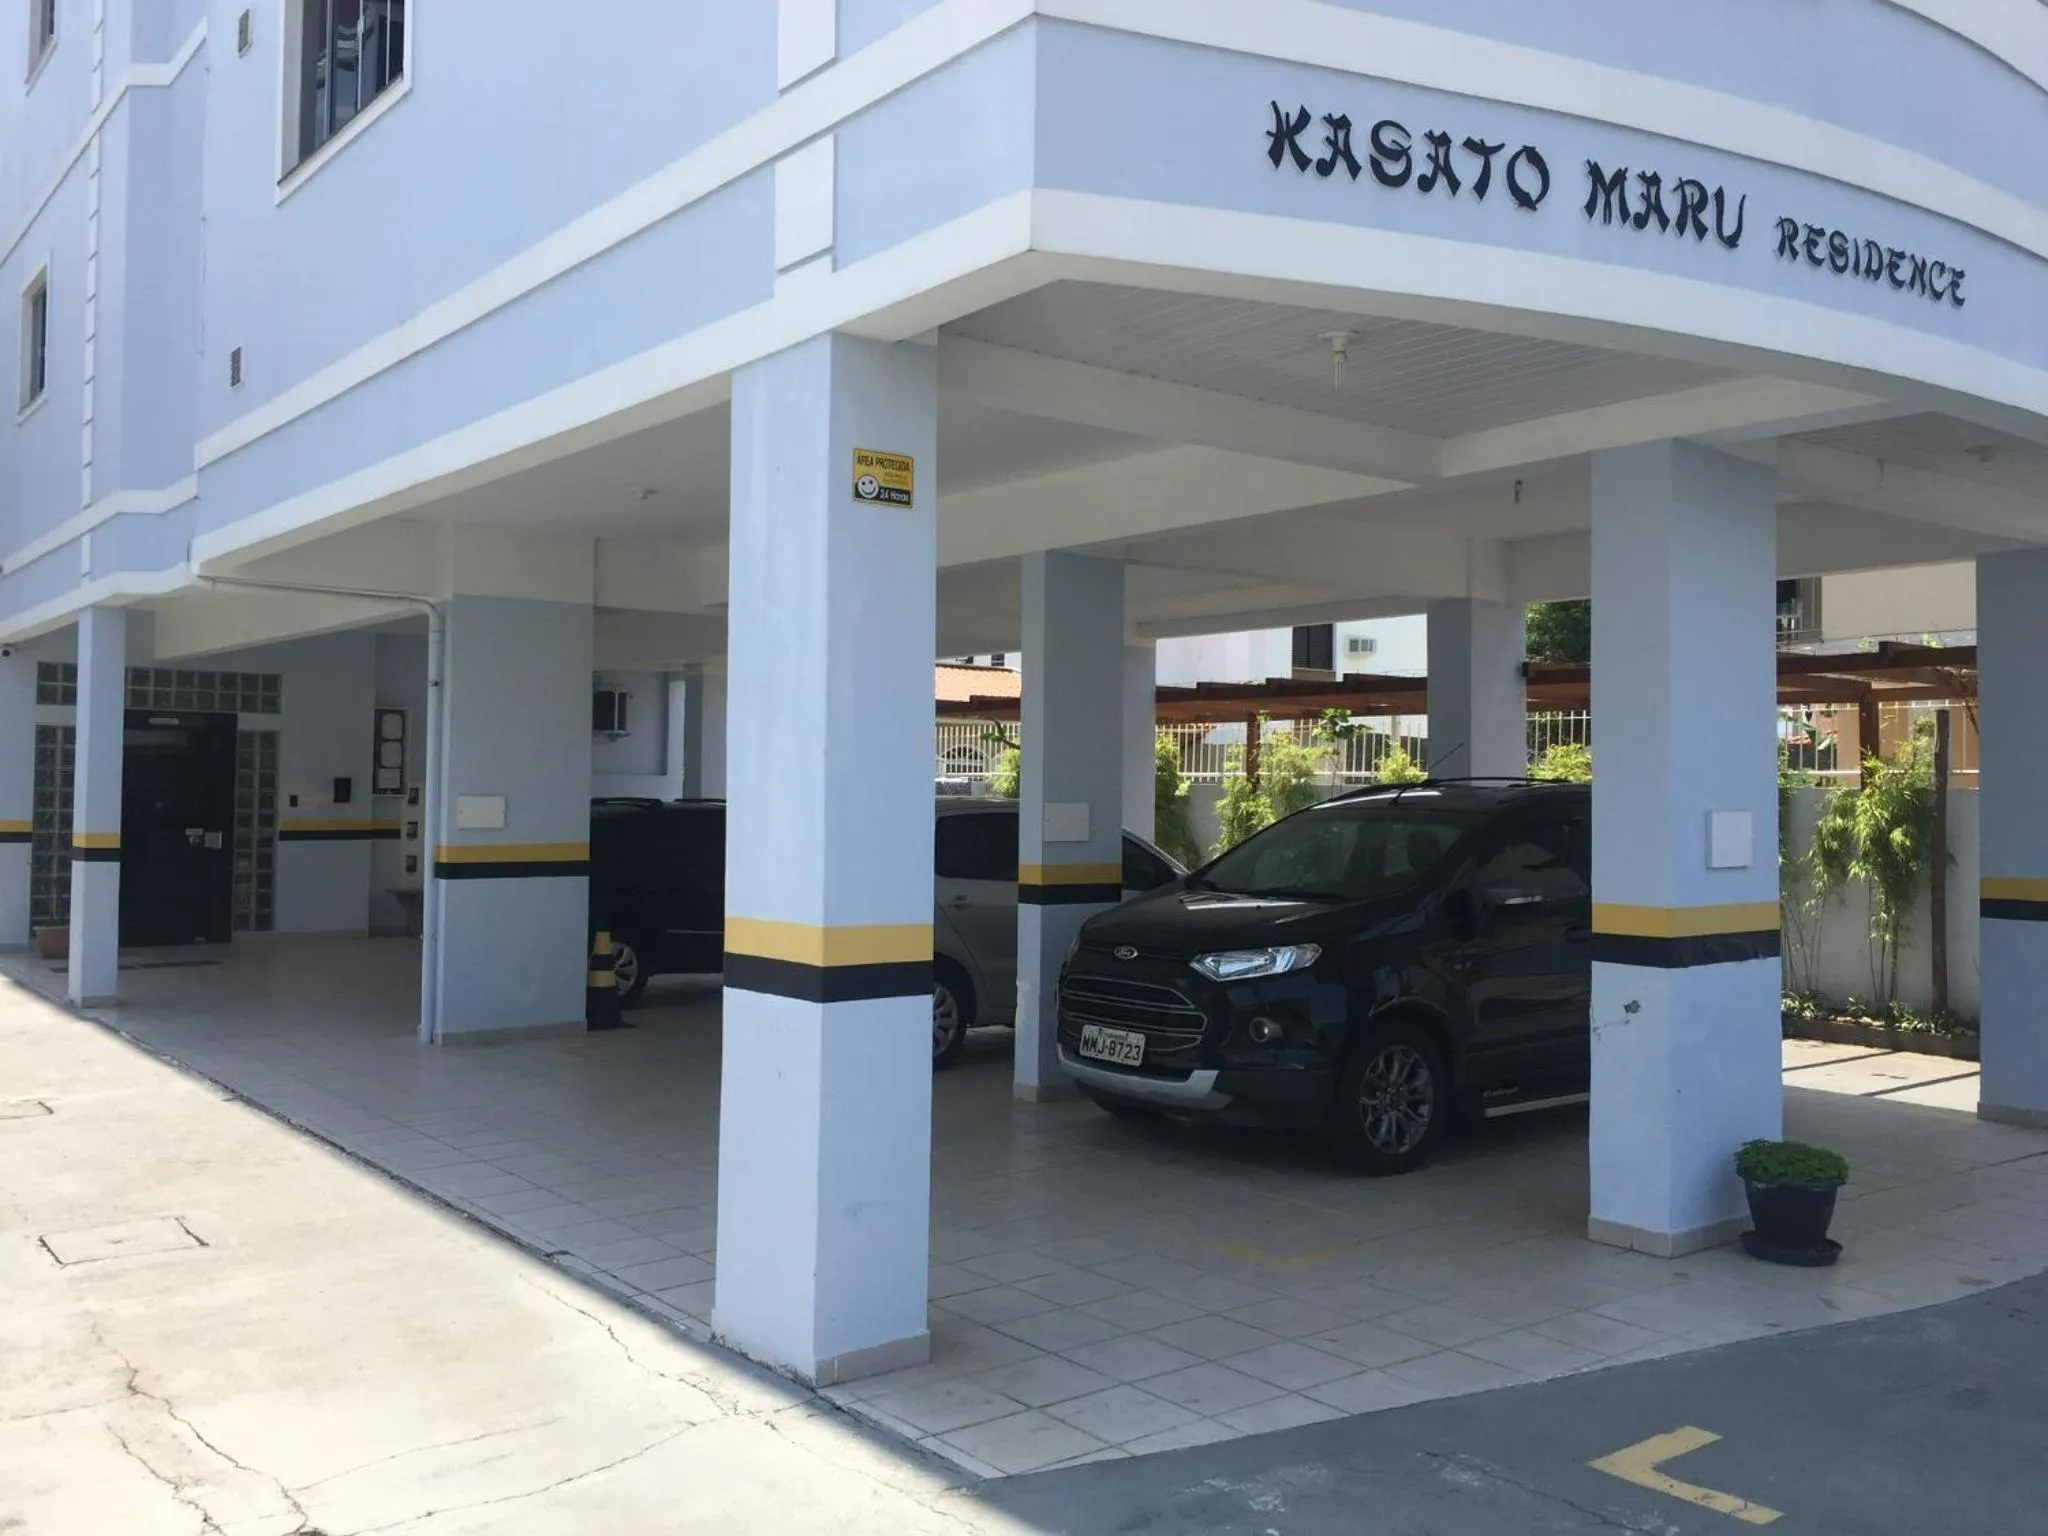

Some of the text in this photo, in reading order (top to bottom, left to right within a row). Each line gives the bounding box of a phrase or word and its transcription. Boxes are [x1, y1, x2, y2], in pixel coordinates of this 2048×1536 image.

[1266, 100, 1967, 308] KASATO MARU RESIDENCE
[880, 488, 889, 499] 24
